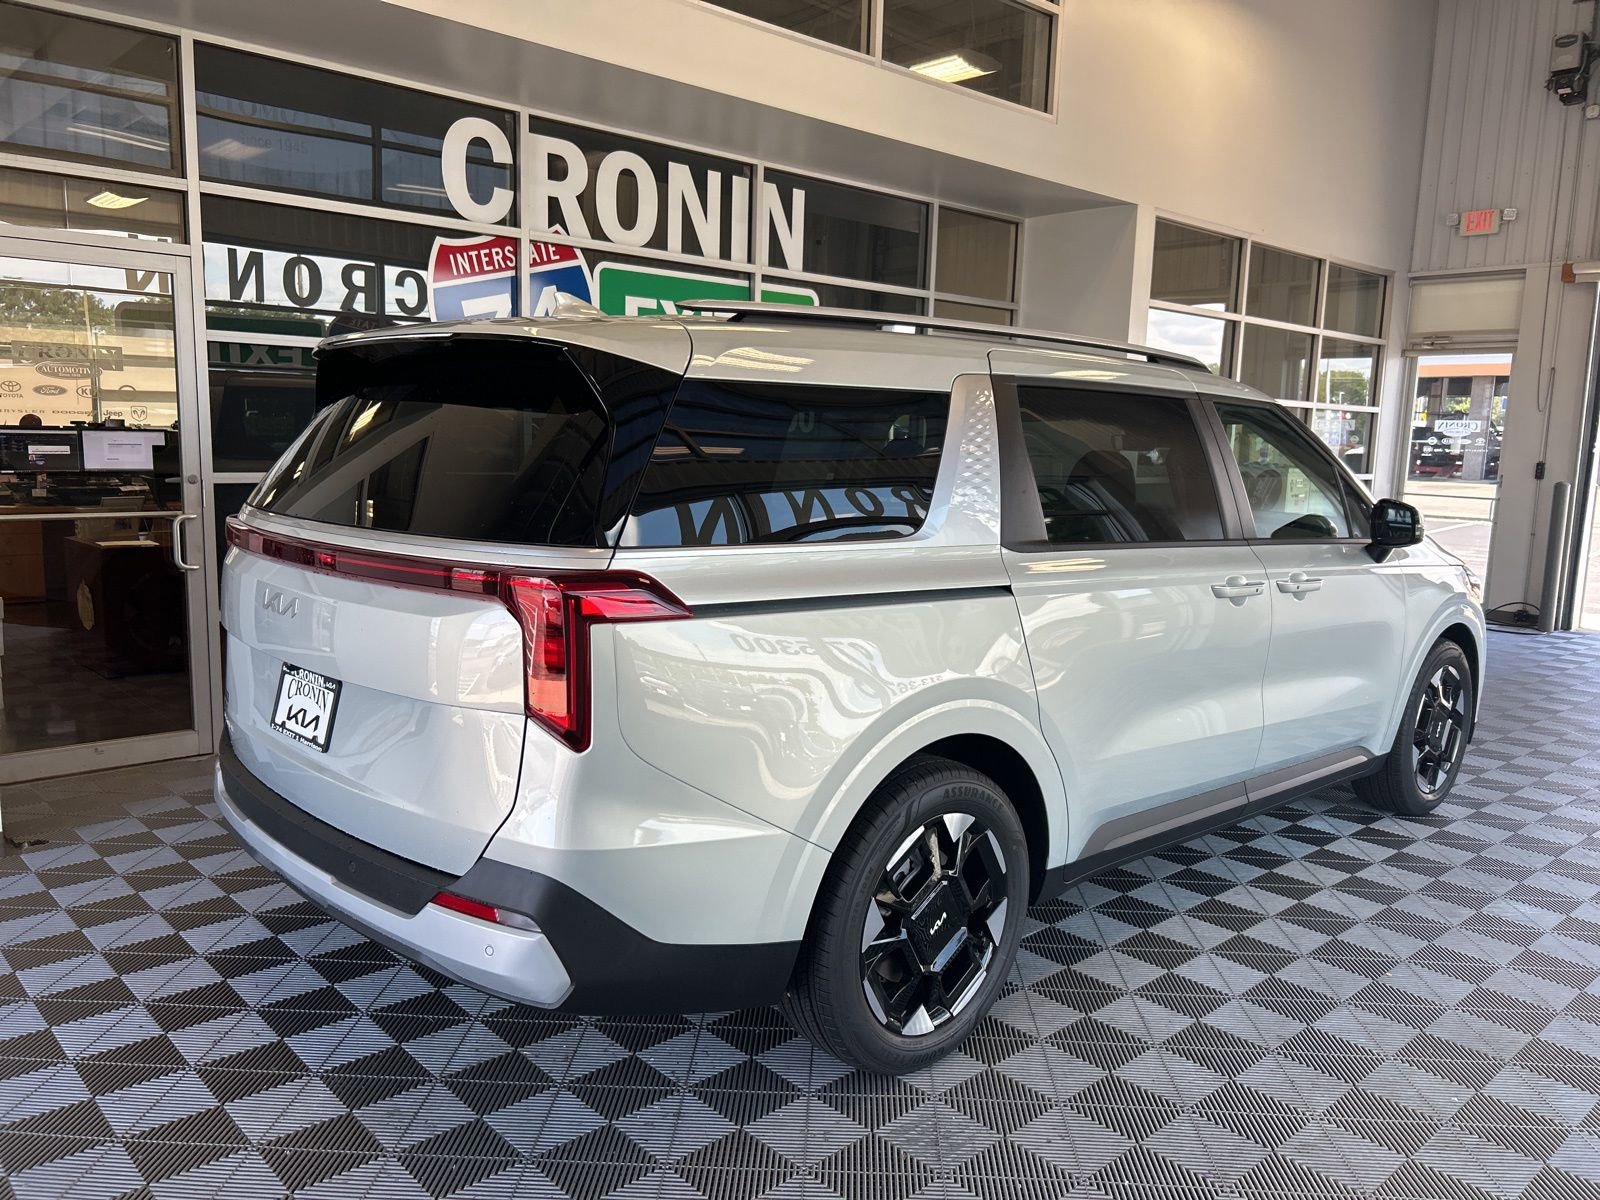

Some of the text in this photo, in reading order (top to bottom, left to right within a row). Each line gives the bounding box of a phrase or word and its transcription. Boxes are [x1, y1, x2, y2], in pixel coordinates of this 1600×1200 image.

[442, 117, 806, 271] CRONIN
[1466, 210, 1495, 232] EXIT
[449, 243, 561, 276] INTERSATE
[41, 364, 93, 375] AUTOMOTIV
[103, 409, 123, 418] Jeep
[287, 678, 330, 714] CRONIN
